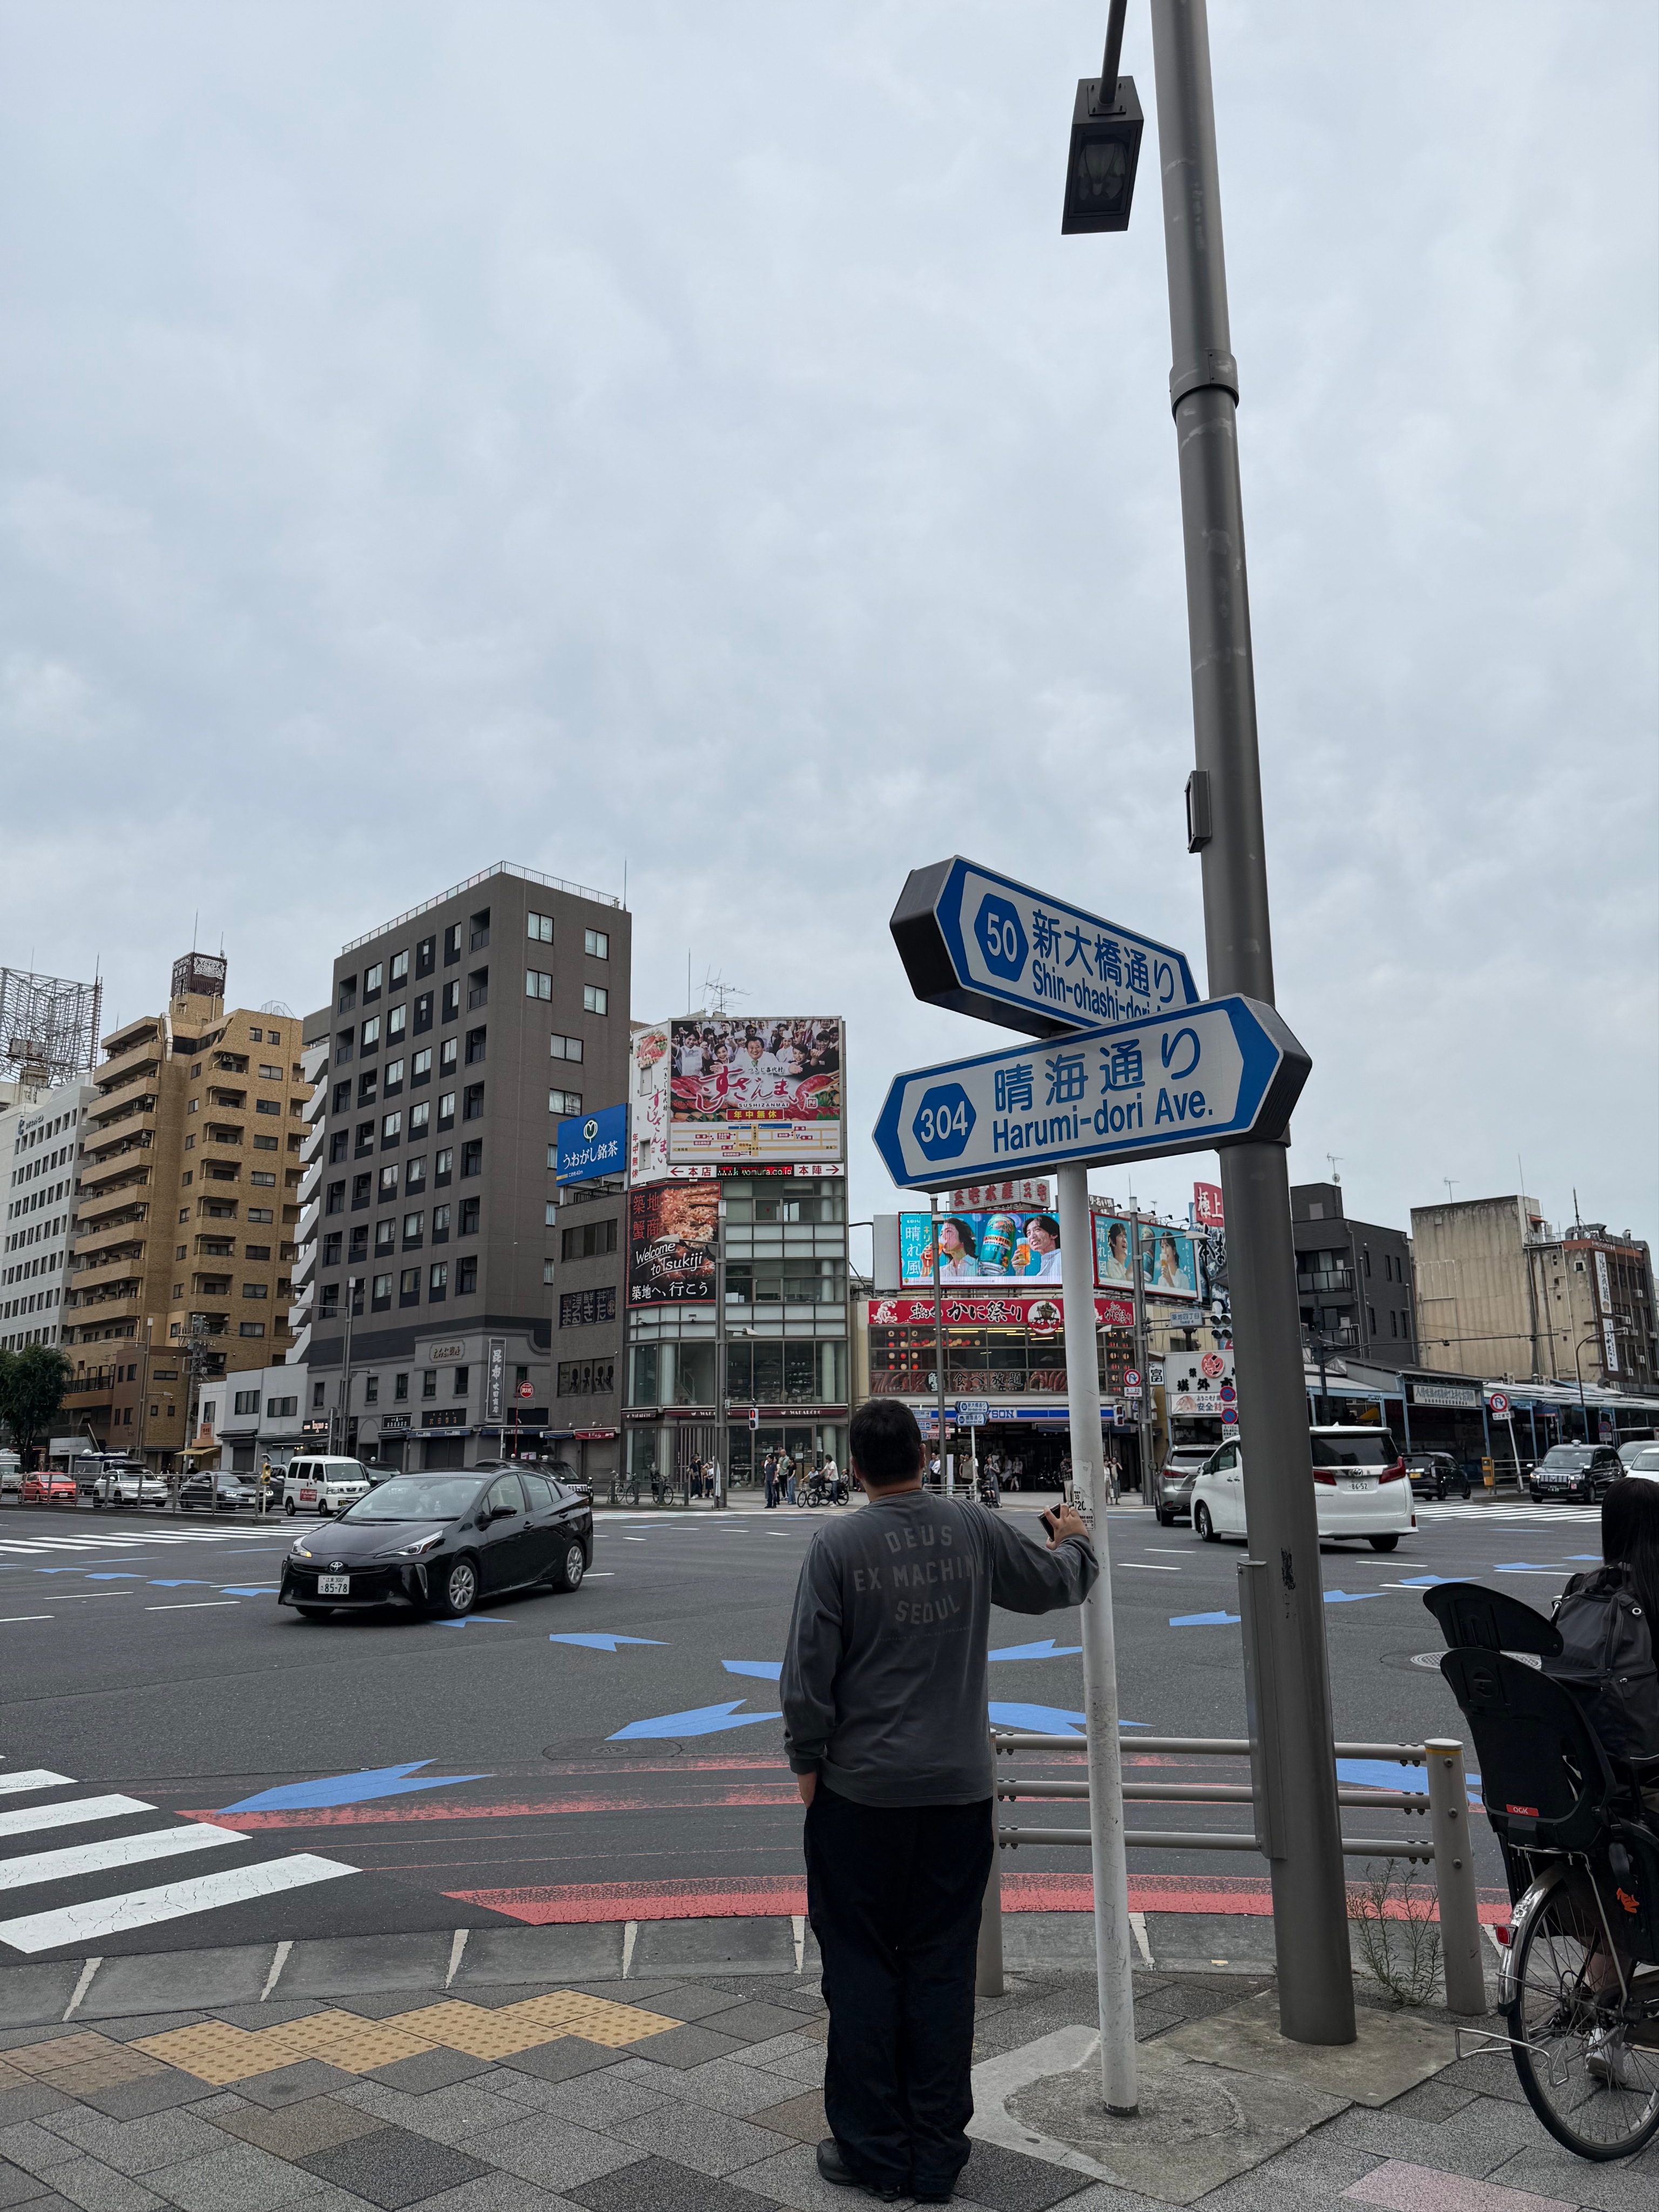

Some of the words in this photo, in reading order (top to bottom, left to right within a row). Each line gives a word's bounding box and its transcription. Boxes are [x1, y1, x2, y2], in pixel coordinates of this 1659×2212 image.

[986, 912, 1017, 962] 50
[1032, 908, 1175, 1003] 新大橋通り
[993, 1028, 1202, 1114] 晴海通り
[733, 1110, 777, 1118] 年中無休
[920, 1100, 969, 1143] 304
[993, 1092, 1143, 1154] Harumi-dori
[1155, 1088, 1213, 1125] Ave.
[563, 1140, 618, 1170] うおがし銘茶
[688, 1167, 711, 1177] 本店
[799, 1165, 822, 1175] 本陣
[633, 1192, 659, 1214] 築地
[954, 1181, 1012, 1206] 三宅水産
[1197, 1186, 1223, 1218] 極上
[633, 1218, 659, 1240] 蟹商
[636, 1243, 676, 1265] Welcome
[905, 1225, 921, 1275] 晴れ風
[1096, 1228, 1108, 1276] 晴れ風
[651, 1262, 661, 1276] to
[659, 1252, 703, 1272] Tsukiji
[632, 1282, 708, 1301] 築地へ、行こう
[946, 1300, 1022, 1322] かに祭り
[1171, 1312, 1200, 1320] 築地四丁目
[491, 1349, 502, 1380] 昆布
[953, 1372, 1022, 1389] 食べ放題
[492, 1382, 500, 1413] 吹田商店
[884, 1525, 952, 1553] DEUS
[325, 1583, 347, 1593] 85-78
[853, 1567, 882, 1591] EX
[894, 1595, 961, 1624] SEOUL
[1513, 1806, 1528, 1815] OGK
